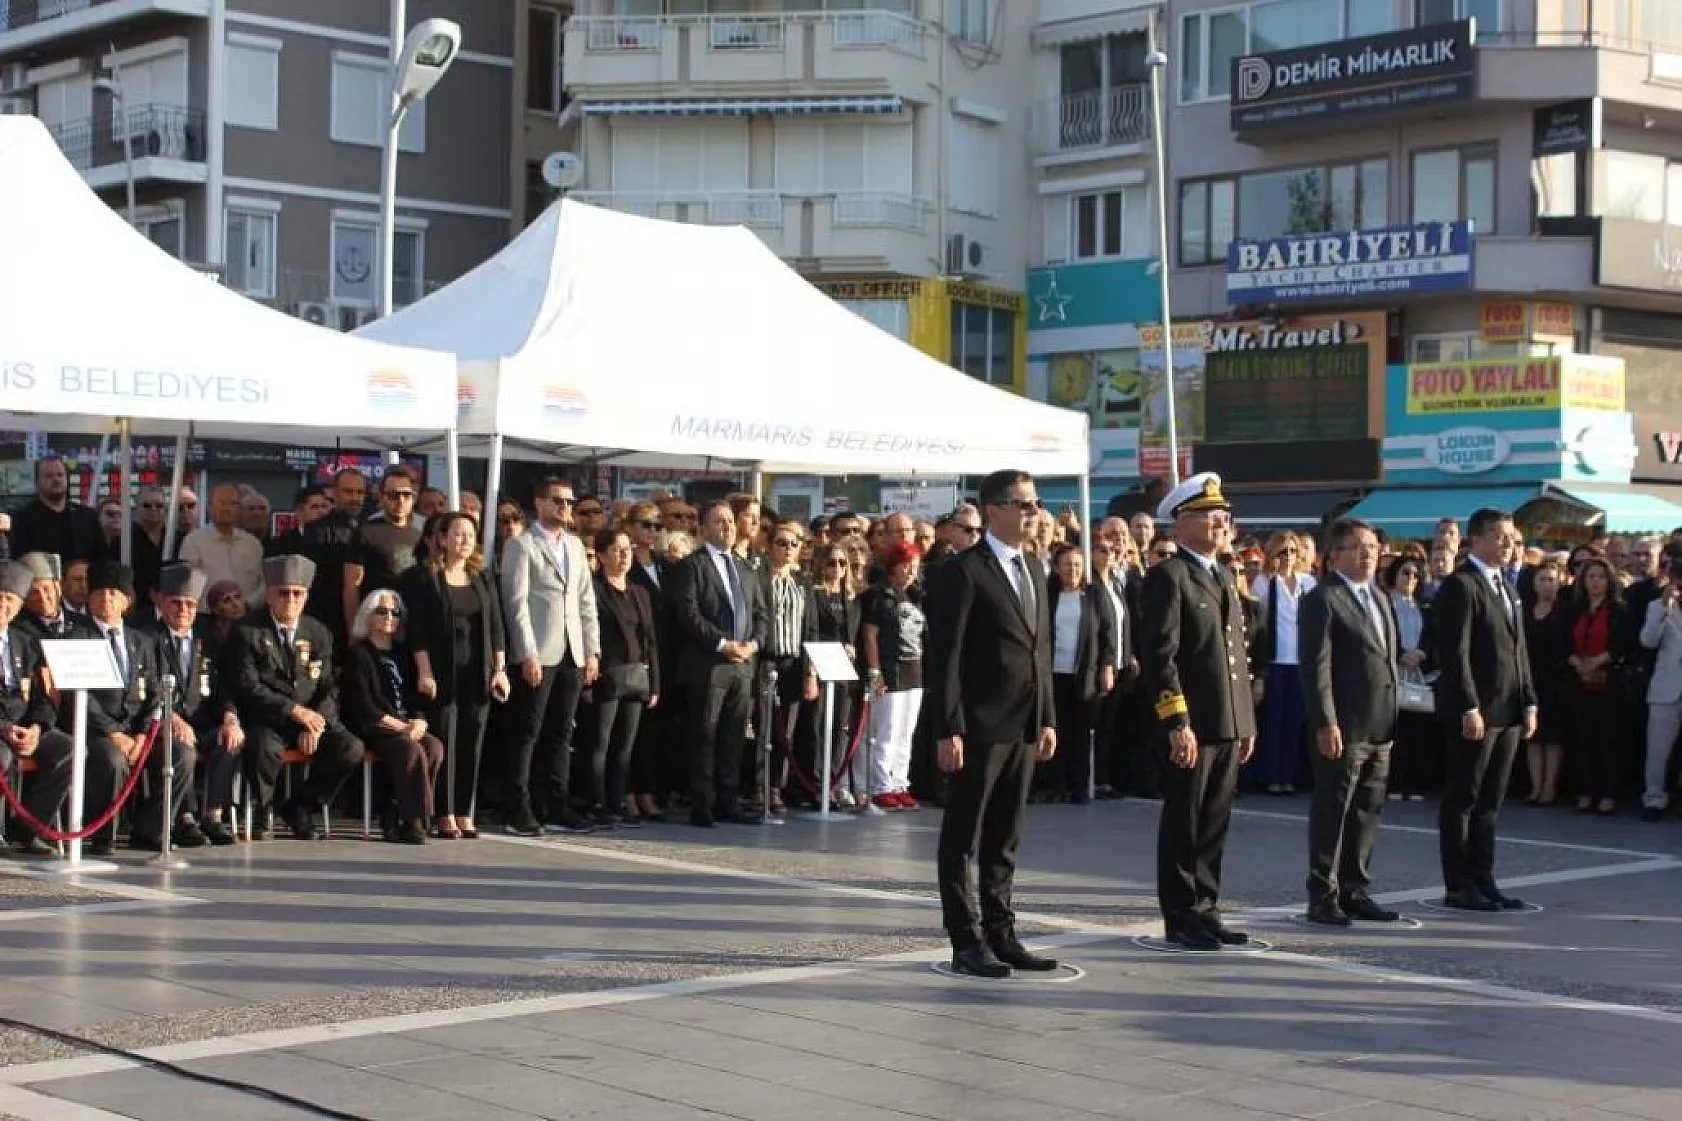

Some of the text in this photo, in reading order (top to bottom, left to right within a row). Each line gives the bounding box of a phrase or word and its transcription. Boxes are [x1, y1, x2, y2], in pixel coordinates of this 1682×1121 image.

[1274, 53, 1342, 87] DEMİR
[1346, 37, 1456, 76] MİMARLIK
[1237, 221, 1454, 271] BAHRİYELİ
[1412, 369, 1466, 395] FOTO
[1471, 361, 1559, 393] YAYLALI
